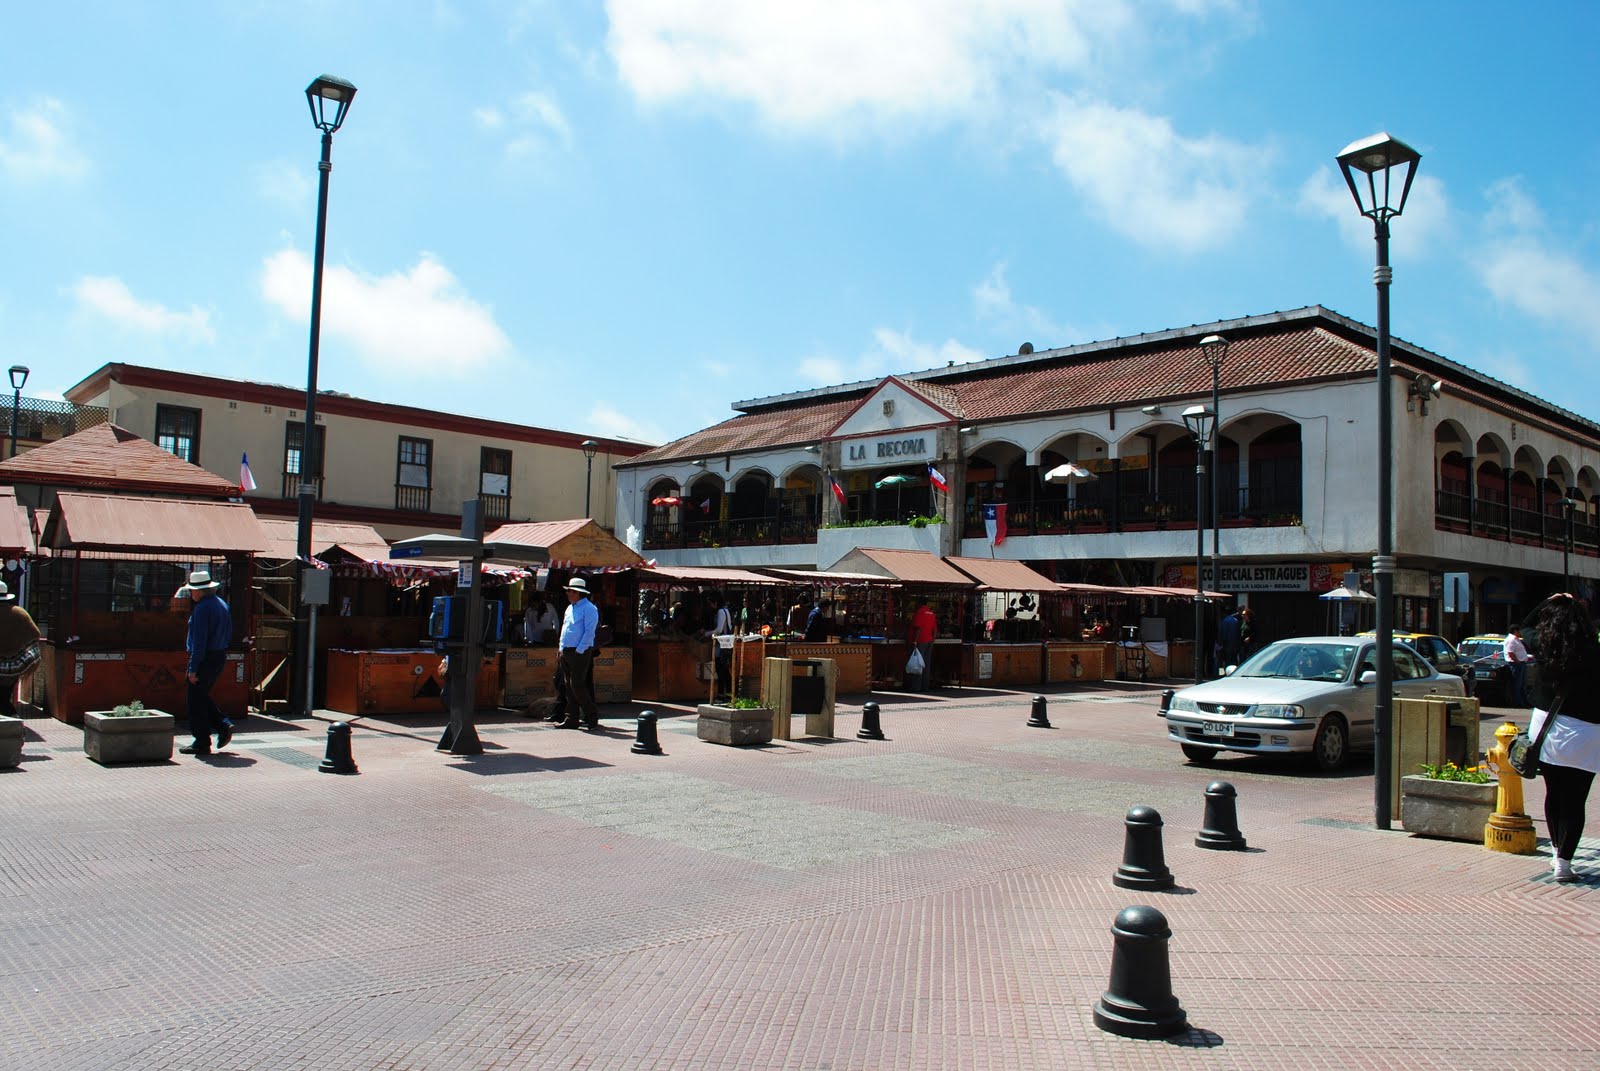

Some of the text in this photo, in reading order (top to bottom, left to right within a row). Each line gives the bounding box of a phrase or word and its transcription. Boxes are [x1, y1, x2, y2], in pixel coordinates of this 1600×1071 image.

[849, 438, 926, 460] LA RECOVA
[1202, 566, 1307, 581] COERCIAL ESTRAGUES
